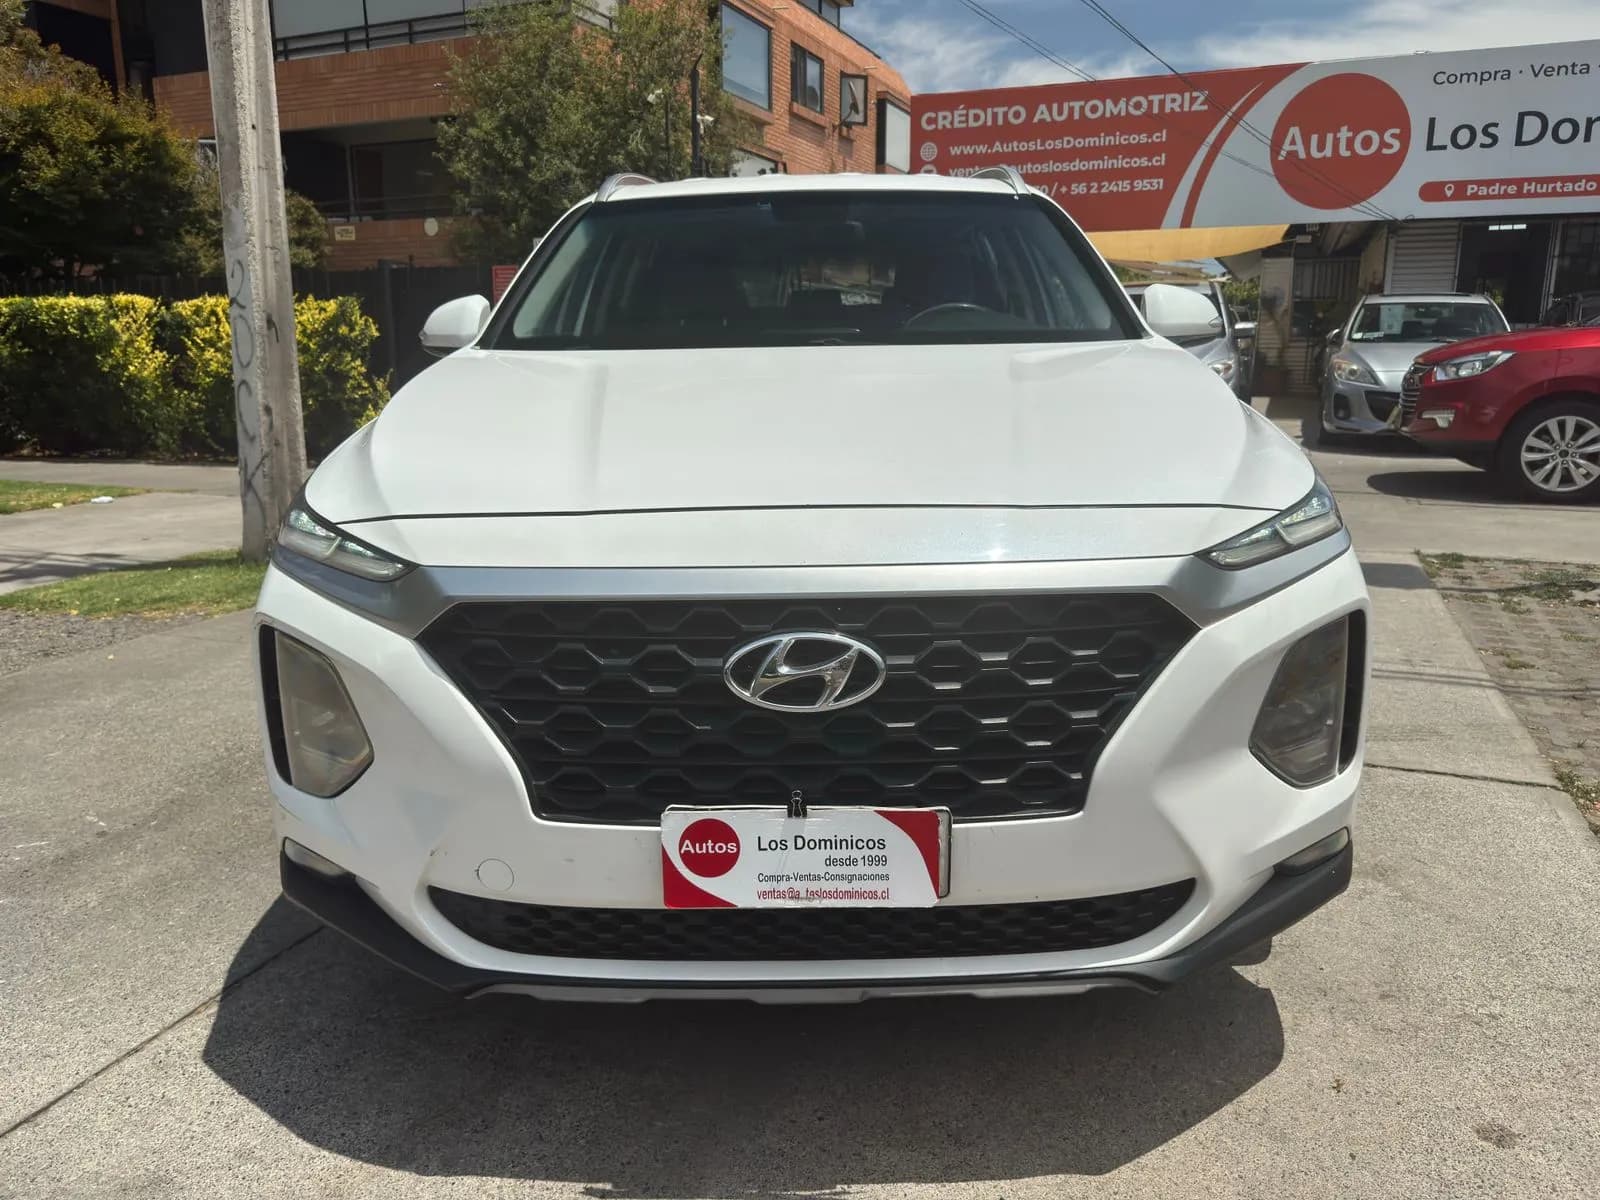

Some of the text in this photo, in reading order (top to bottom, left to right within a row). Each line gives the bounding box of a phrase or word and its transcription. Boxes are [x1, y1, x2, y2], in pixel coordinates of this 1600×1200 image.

[1433, 61, 1590, 86] Compra Venta
[920, 90, 1209, 131] CRÉDITO AUTOMOTRIZ
[948, 129, 1167, 156] www.AutosLosDominicos.cl
[1278, 125, 1401, 160] Autos
[1426, 117, 1499, 151] Los
[1089, 181, 1099, 194] 2
[1101, 180, 1131, 193] 2415
[1133, 178, 1164, 192] 9531
[1466, 179, 1597, 197] Padre Hurtado
[680, 839, 738, 854] Autos
[757, 834, 887, 851] Los Dominicos
[824, 854, 887, 867] desde 1999
[757, 871, 890, 884] Compra-Ventas-Consignaciones
